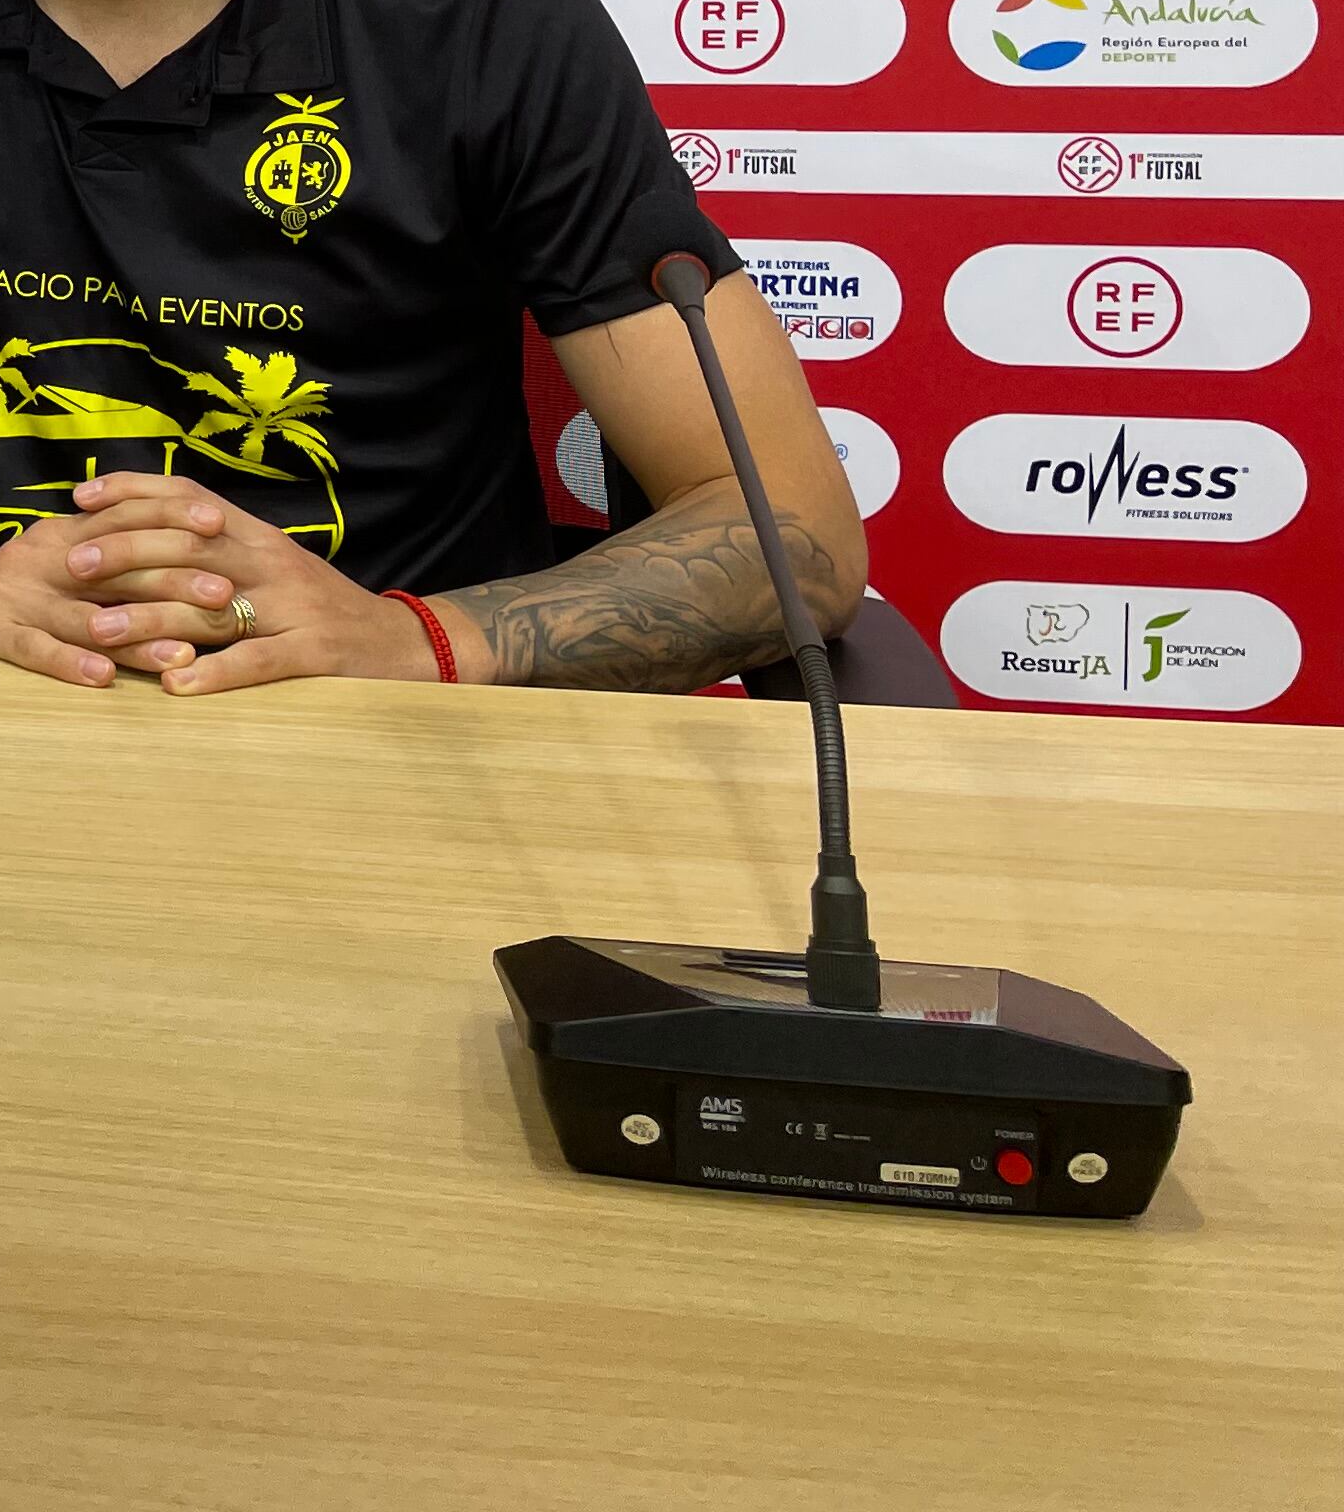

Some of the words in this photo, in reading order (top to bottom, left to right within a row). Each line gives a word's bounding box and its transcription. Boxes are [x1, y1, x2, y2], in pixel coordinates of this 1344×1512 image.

[1102, 37, 1152, 50] Región
[1158, 37, 1219, 49] Europea
[1225, 37, 1247, 47] del
[1102, 53, 1176, 62] DEPORTE
[273, 130, 331, 146] JAEN
[1147, 161, 1201, 179] FUTSAL
[244, 187, 274, 218] FUTBOL
[309, 200, 338, 220] SALA
[85, 277, 147, 321] PAA
[160, 297, 303, 330] EVENTOS
[1126, 509, 1169, 518] FITNESS
[1173, 511, 1232, 521] SOLUTIONS
[1167, 645, 1245, 656] DIPUTACIÓN
[1001, 652, 1110, 679] ResurJA
[1167, 657, 1183, 666] DE
[1187, 658, 1218, 667] JAÉN
[701, 1097, 742, 1114] AMS
[995, 1130, 1034, 1140] POWER
[702, 1166, 766, 1183] Wireless
[770, 1175, 854, 1191] conference
[859, 1183, 953, 1198] transmission
[959, 1193, 1012, 1205] system
